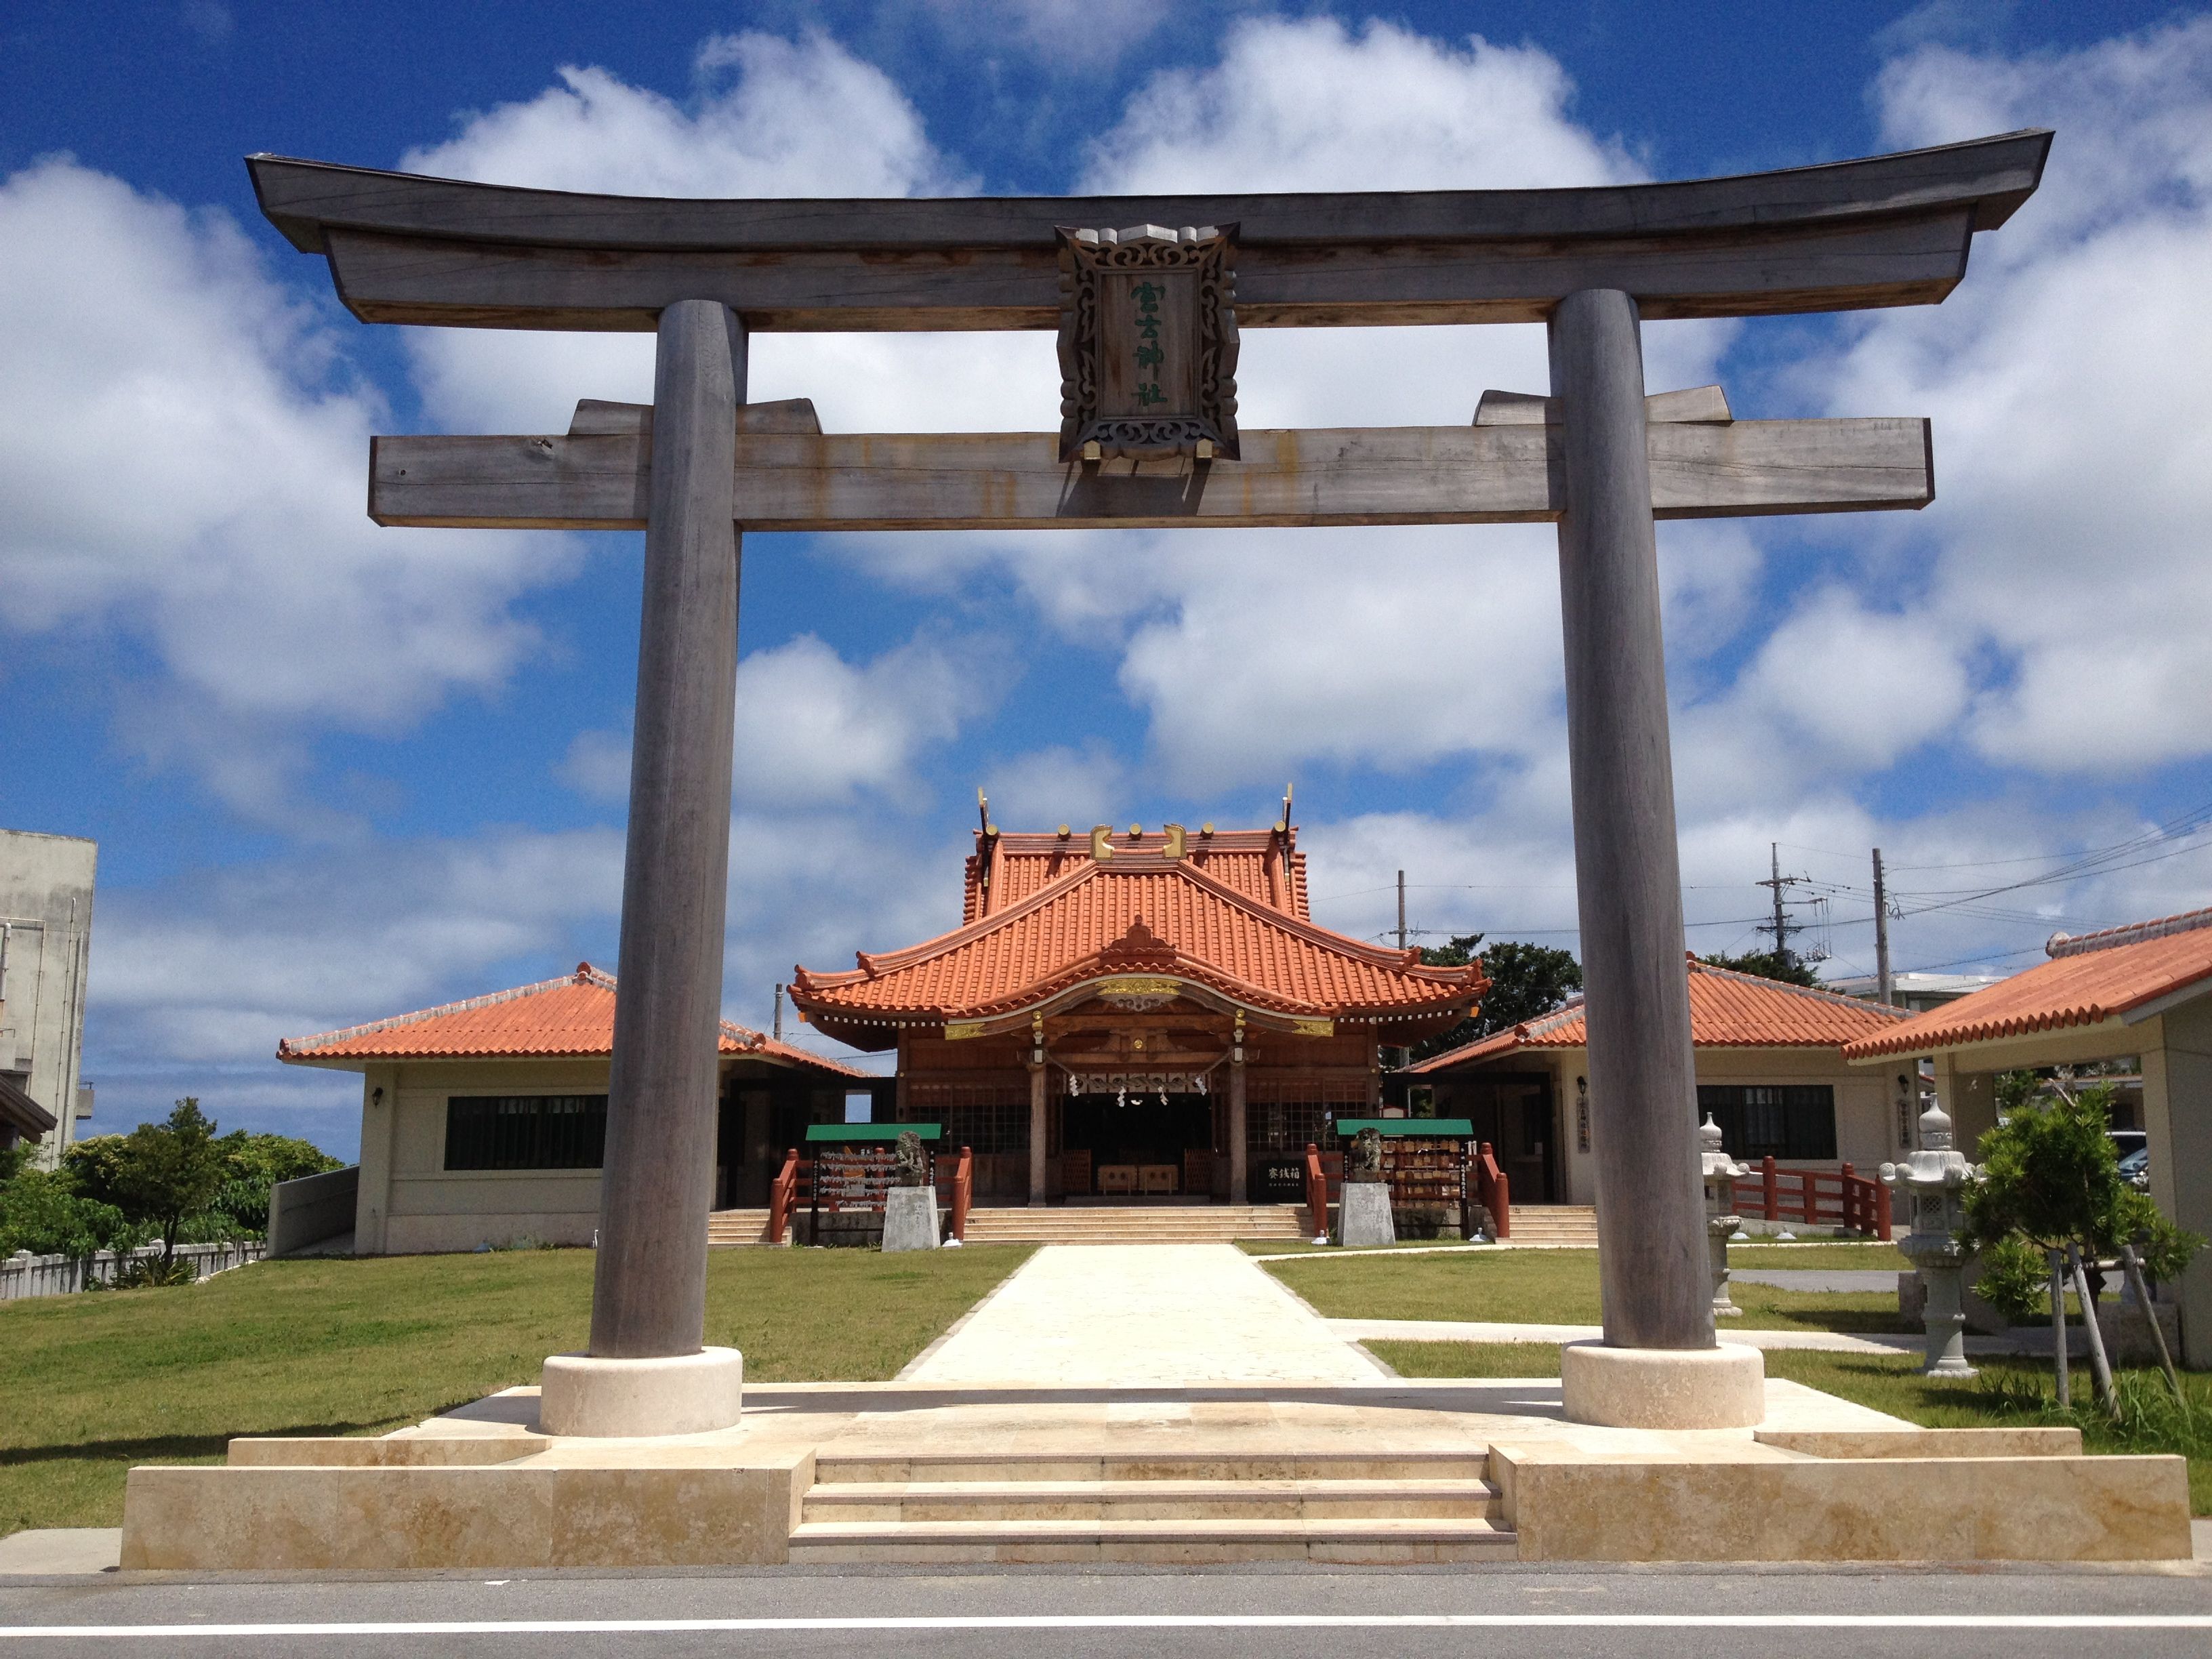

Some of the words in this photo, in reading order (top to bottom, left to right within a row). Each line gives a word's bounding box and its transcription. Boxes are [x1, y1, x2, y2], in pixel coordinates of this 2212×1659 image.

[1130, 281, 1168, 407] 宮古神社
[1269, 1167, 1300, 1179] 賽銭箱
